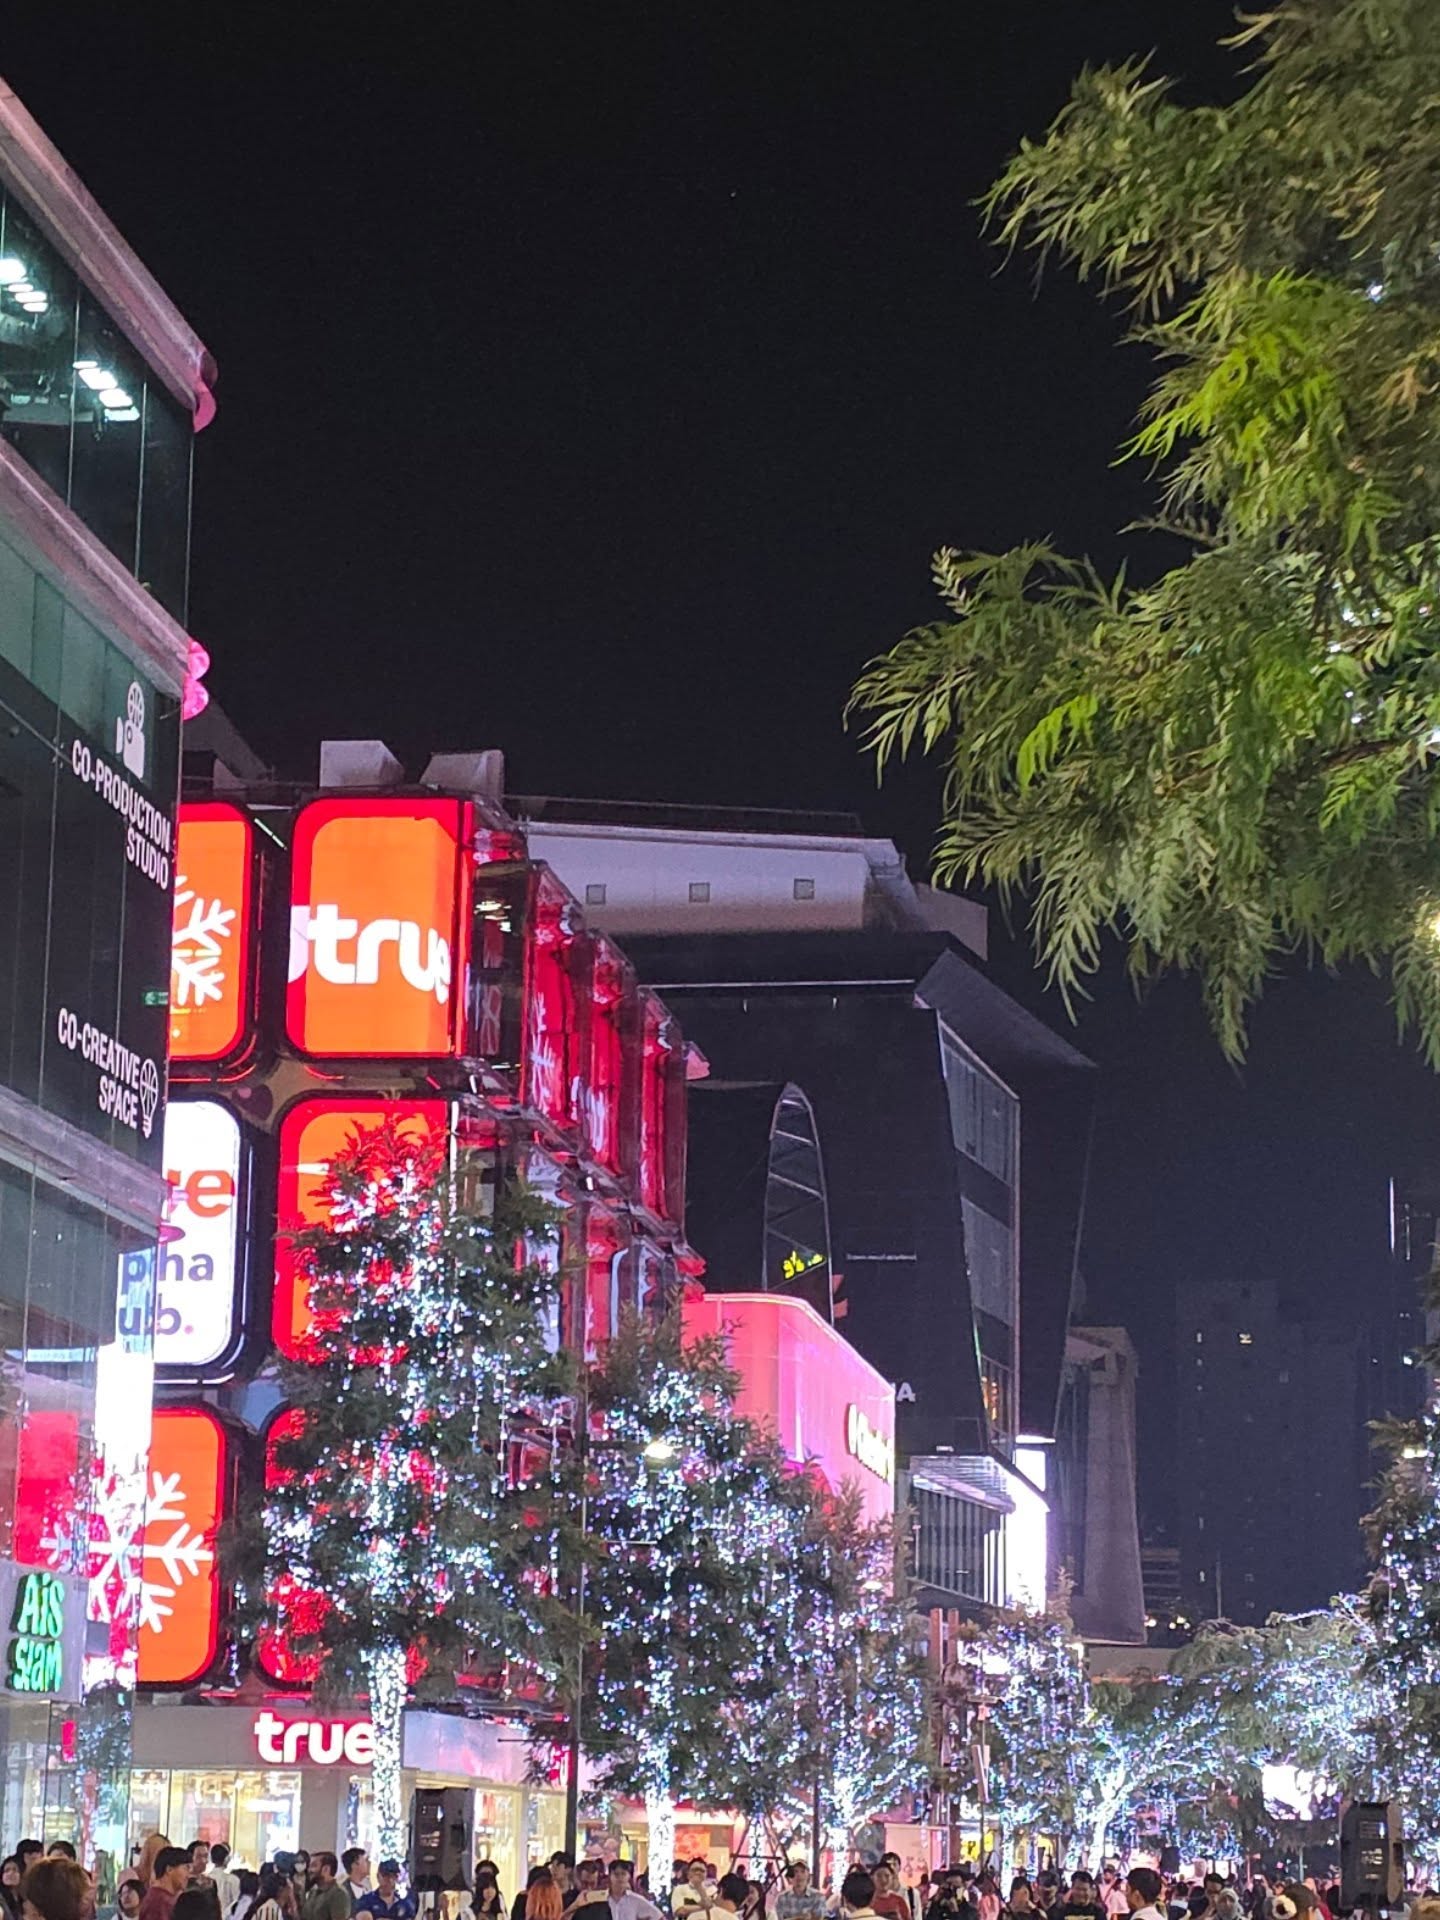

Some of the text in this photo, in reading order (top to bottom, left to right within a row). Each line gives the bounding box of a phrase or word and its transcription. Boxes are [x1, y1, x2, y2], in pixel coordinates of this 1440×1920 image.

[72, 739, 170, 853] CO-PRODUCTION
[126, 827, 169, 890] STUDIO
[58, 1007, 141, 1090] CO-CREATIVE
[99, 1075, 139, 1130] SPACE
[254, 1712, 375, 1764] true
